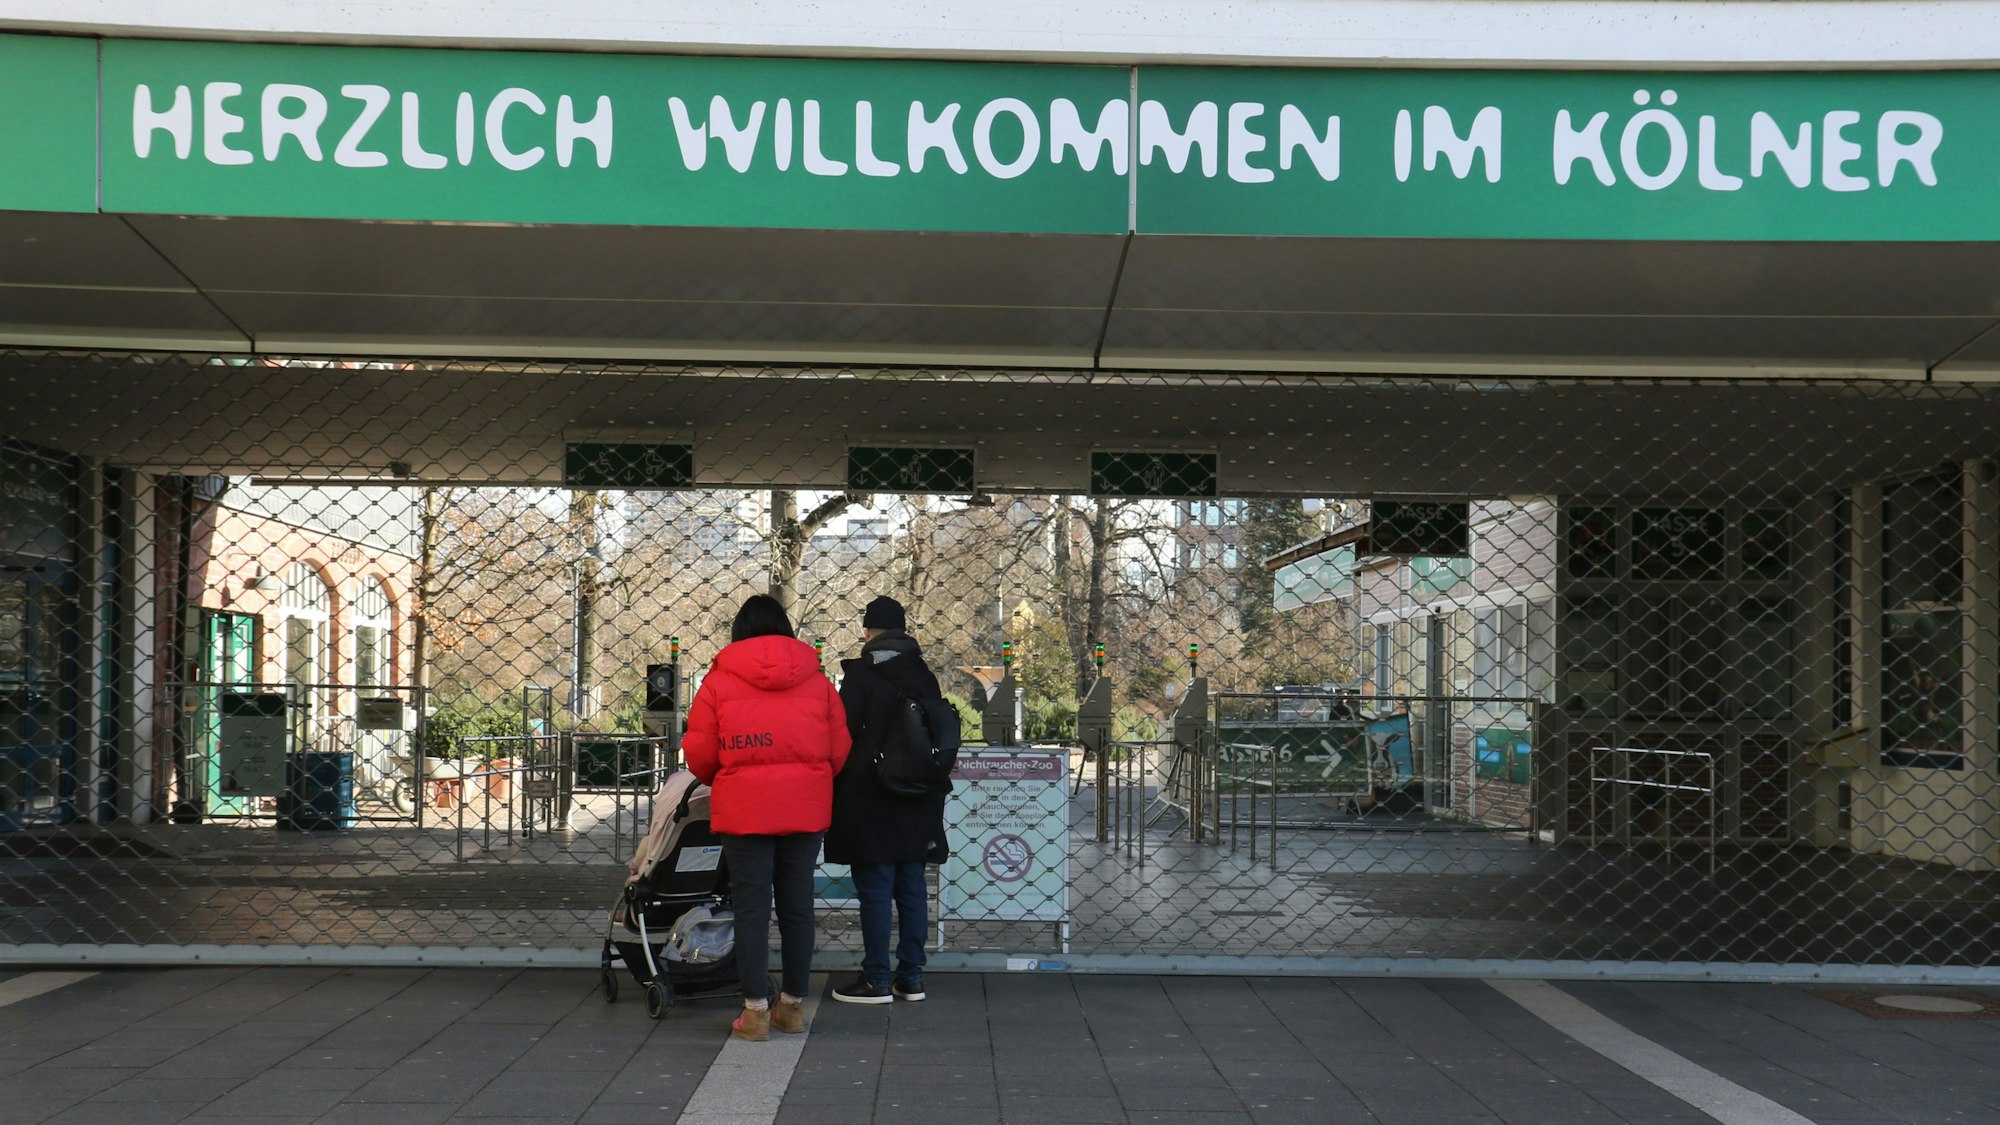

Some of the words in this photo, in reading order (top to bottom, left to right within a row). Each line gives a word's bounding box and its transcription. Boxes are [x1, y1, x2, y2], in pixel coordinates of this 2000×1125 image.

[133, 82, 612, 171] HERZLICH
[668, 96, 1340, 182] WILLKOMMEN
[1395, 106, 1501, 182] IM
[1554, 89, 1942, 191] KÖLNER
[1395, 506, 1444, 520] KASSE
[1648, 515, 1709, 532] KASSE
[729, 732, 773, 751] JEANS
[1279, 743, 1293, 763] 6
[958, 760, 1054, 770] Nichtraucher-Zoo
